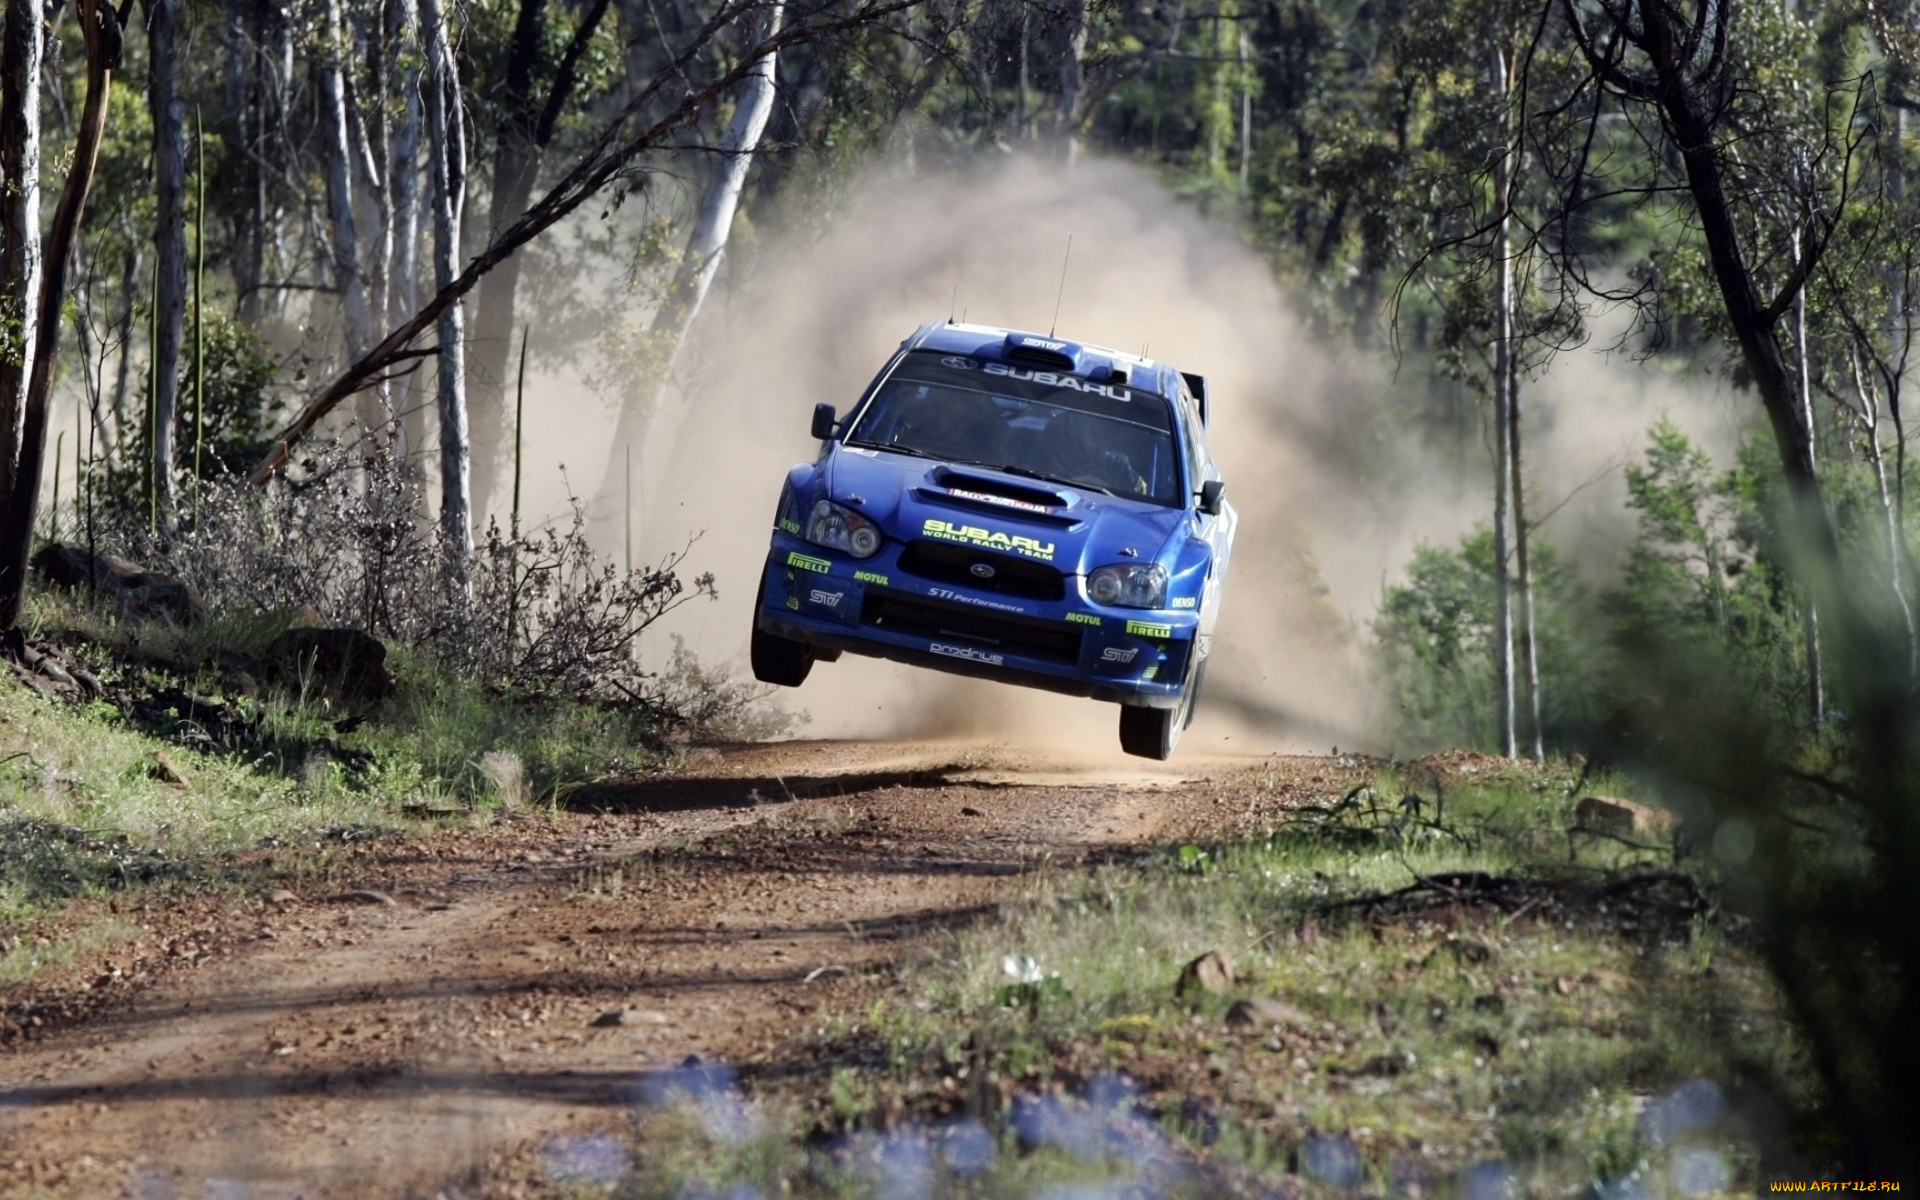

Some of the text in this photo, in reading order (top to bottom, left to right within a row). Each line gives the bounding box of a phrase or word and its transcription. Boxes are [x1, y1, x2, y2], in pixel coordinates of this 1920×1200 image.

[983, 362, 1131, 402] SUBARU
[954, 489, 985, 502] RALLY
[780, 519, 800, 534] DENSO
[923, 519, 1055, 554] SUBARU
[922, 530, 1053, 561] WORLD RALLY TEAM
[787, 552, 831, 574] PIRELLI
[853, 571, 889, 585] MOTUL
[927, 587, 1024, 613] STI Performance
[1171, 597, 1196, 608] DENSO
[1065, 612, 1101, 626] MOTUL
[1126, 619, 1171, 638] PIRELLI
[929, 643, 1004, 664] prodrive
